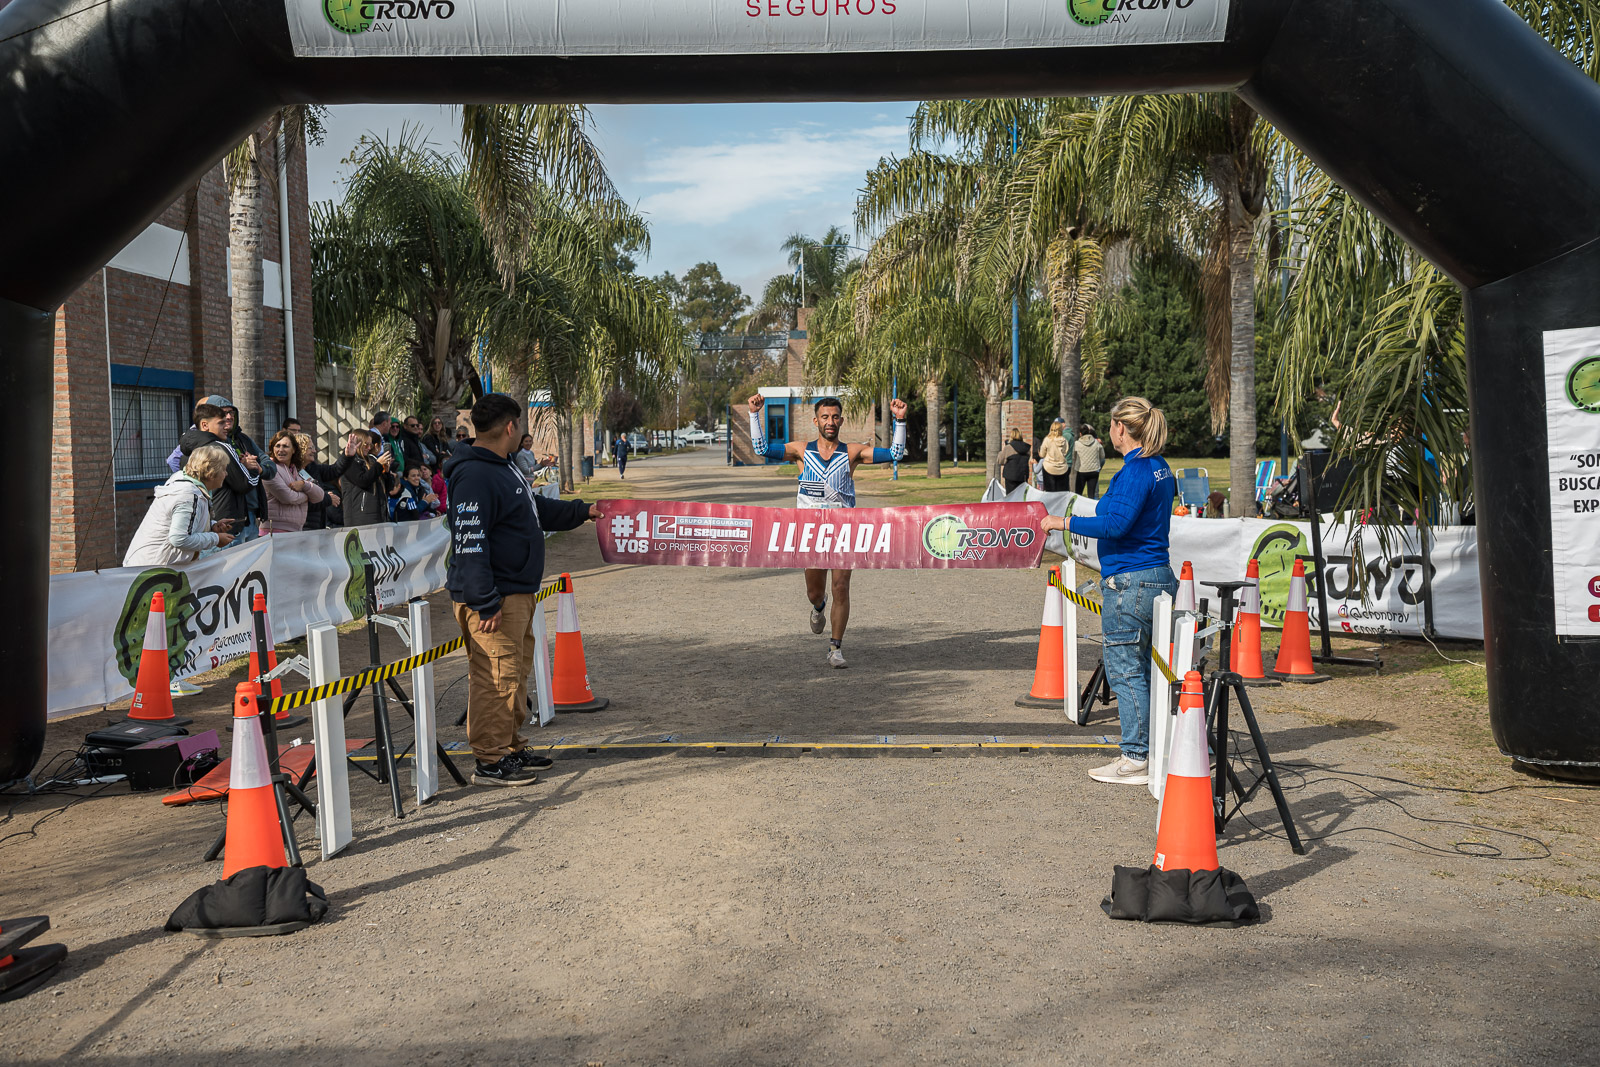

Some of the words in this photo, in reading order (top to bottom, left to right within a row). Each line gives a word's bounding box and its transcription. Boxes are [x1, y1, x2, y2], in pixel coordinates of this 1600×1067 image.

[360, 0, 455, 20] CRONO
[746, 0, 897, 17] SEGUROS
[1099, 14, 1132, 24] RAV
[360, 23, 393, 33] RAV
[611, 511, 649, 538] #1
[678, 525, 692, 536] La
[693, 527, 748, 539] segunda
[767, 522, 891, 553] LLEGADA
[614, 538, 649, 554] VOS
[654, 542, 668, 551] LO
[669, 542, 708, 552] PRIMERO
[709, 543, 727, 552] SOS
[729, 544, 748, 553] VOS
[952, 549, 987, 560] RAV
[1349, 607, 1410, 623] @cronorav
[215, 630, 252, 652] @cronora
